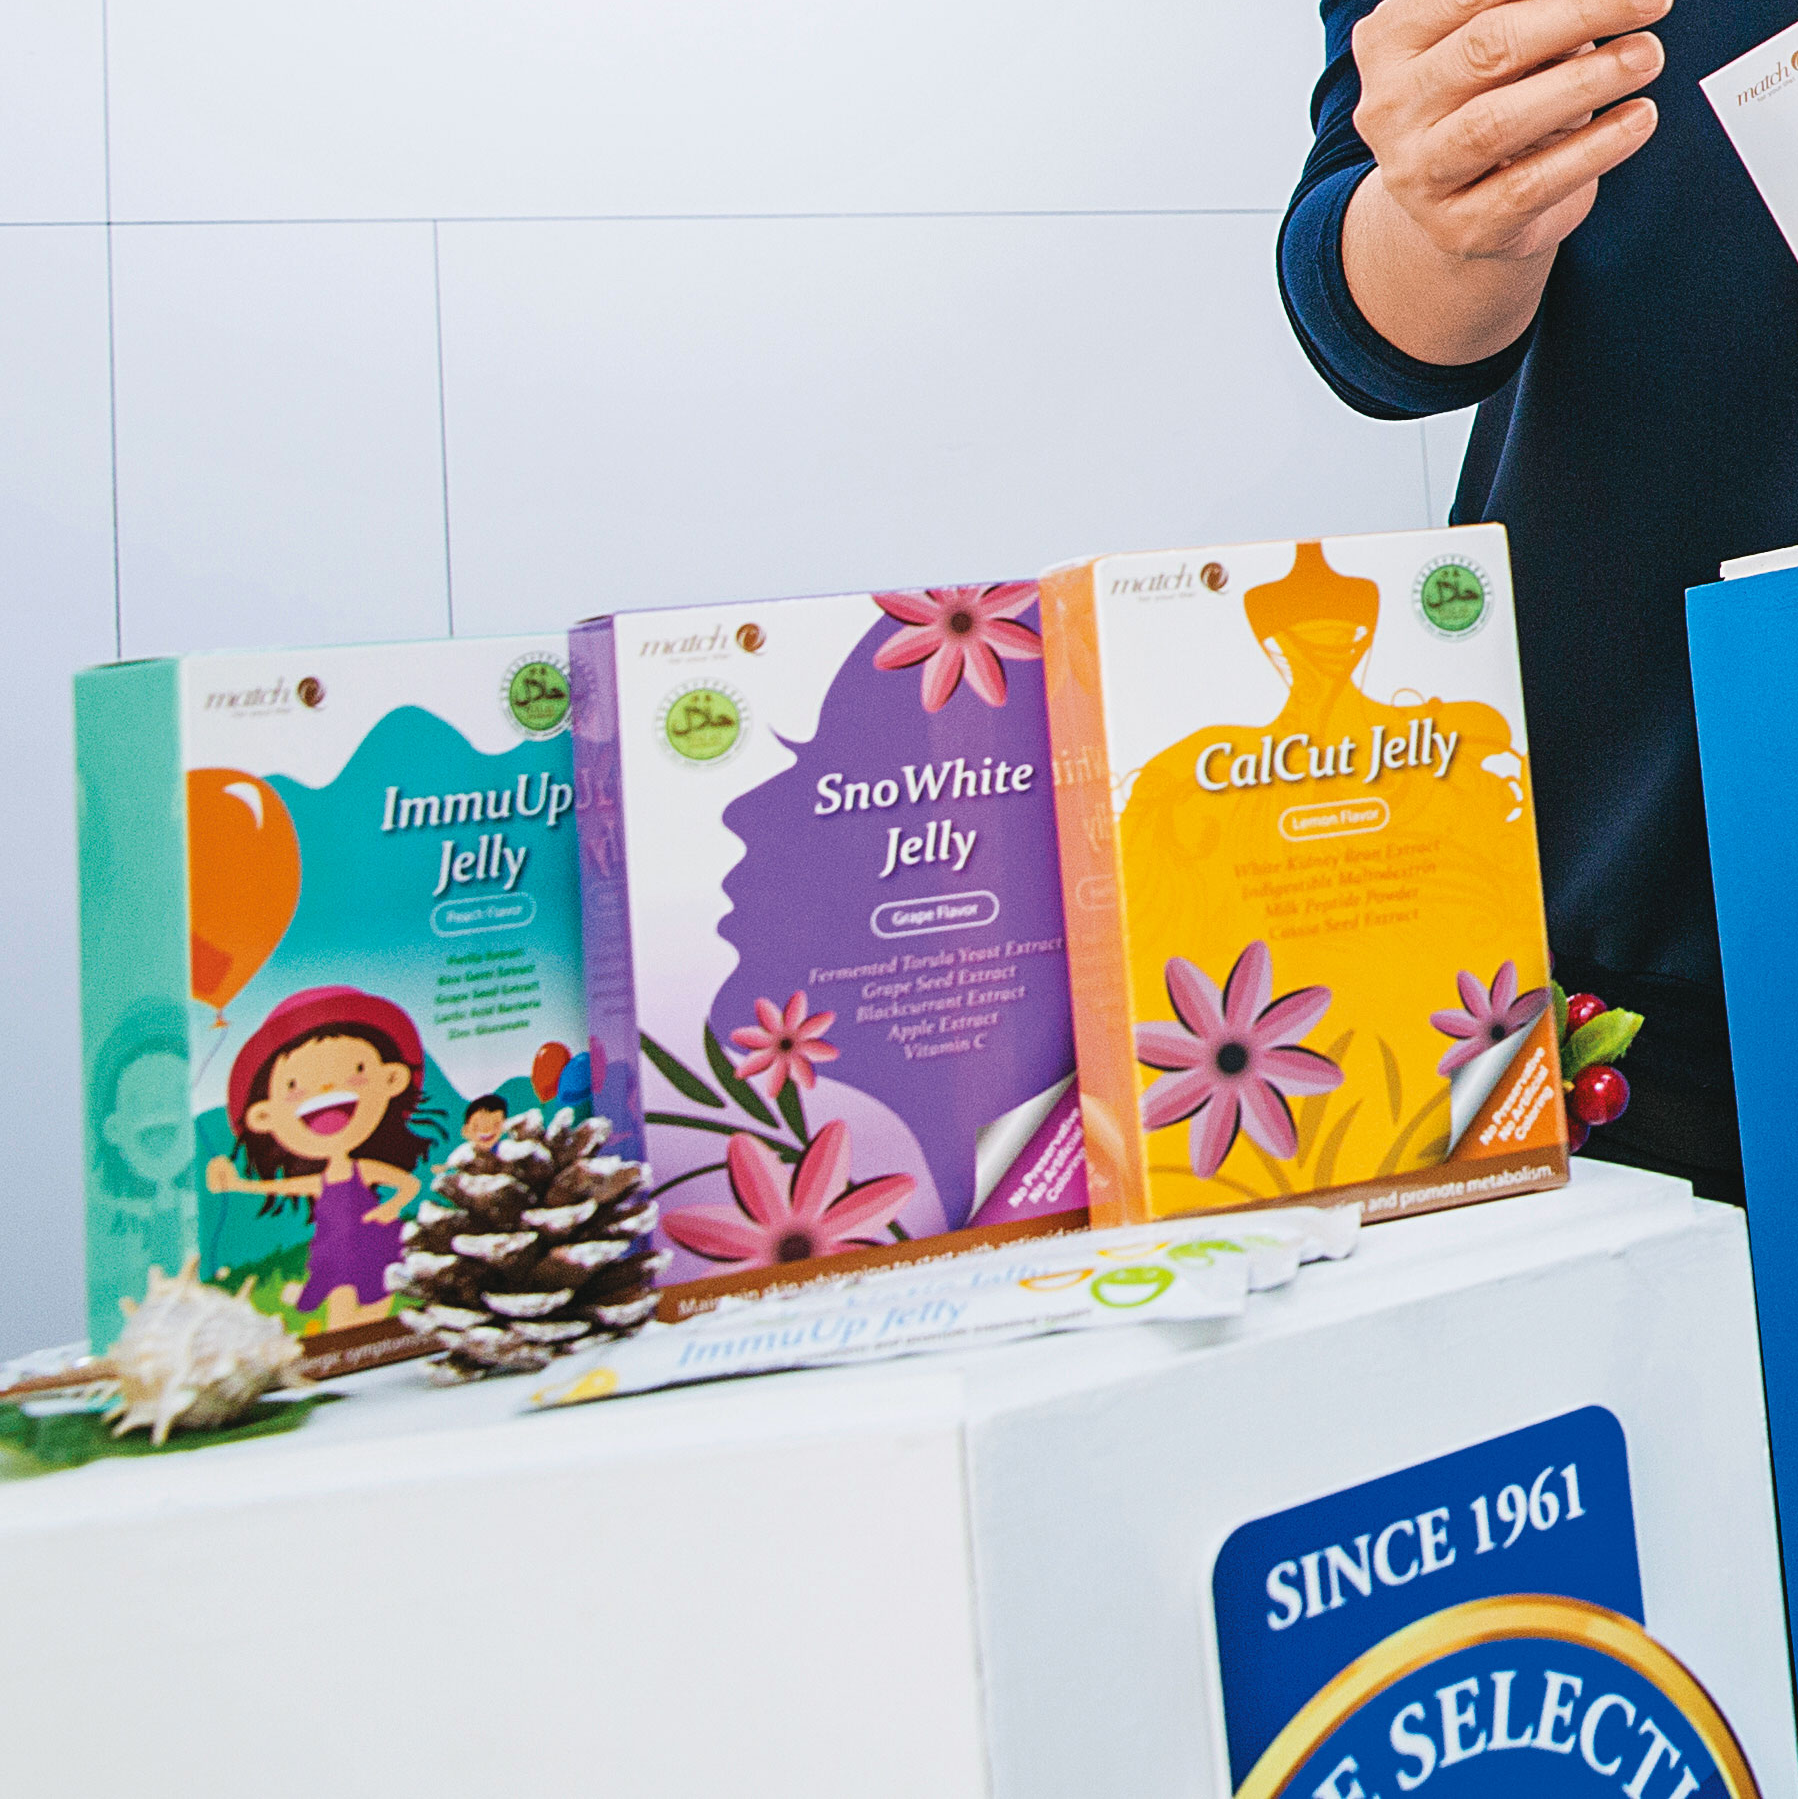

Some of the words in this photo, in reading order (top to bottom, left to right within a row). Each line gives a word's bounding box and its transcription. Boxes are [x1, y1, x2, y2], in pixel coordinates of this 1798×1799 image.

[1737, 61, 1790, 107] match
[1110, 562, 1194, 597] match
[638, 623, 730, 659] match
[1195, 732, 1357, 792] CalCut
[1363, 717, 1459, 784] Jelly
[381, 771, 574, 832] ImmuUp
[814, 757, 1035, 816] SnoWhite
[1291, 811, 1339, 831] Lemon
[1340, 807, 1380, 825] Flavor
[431, 832, 528, 897] Jelly
[879, 818, 977, 879] Jelly
[891, 909, 935, 927] Grape
[935, 903, 980, 921] Flavor
[808, 956, 898, 986] Fermented
[1004, 937, 1066, 958] Extract
[861, 981, 913, 1000] Grape
[914, 970, 954, 991] Seed
[957, 964, 1018, 987] Extract
[966, 985, 1026, 1005] Extract
[886, 1018, 936, 1043] Apple
[938, 1011, 999, 1034] Extract
[903, 1037, 971, 1060] Vitamin
[973, 1032, 988, 1050] C
[1479, 1123, 1498, 1146] No
[1491, 1046, 1546, 1126] Preservative
[1498, 1119, 1516, 1142] No
[1007, 1186, 1028, 1208] No
[1028, 1182, 1047, 1204] No
[1368, 1190, 1398, 1214] and
[1399, 1181, 1466, 1208] promote
[1466, 1164, 1556, 1193] metabolism.
[1265, 1506, 1457, 1631] SINCE
[1470, 1462, 1587, 1555] 1961
